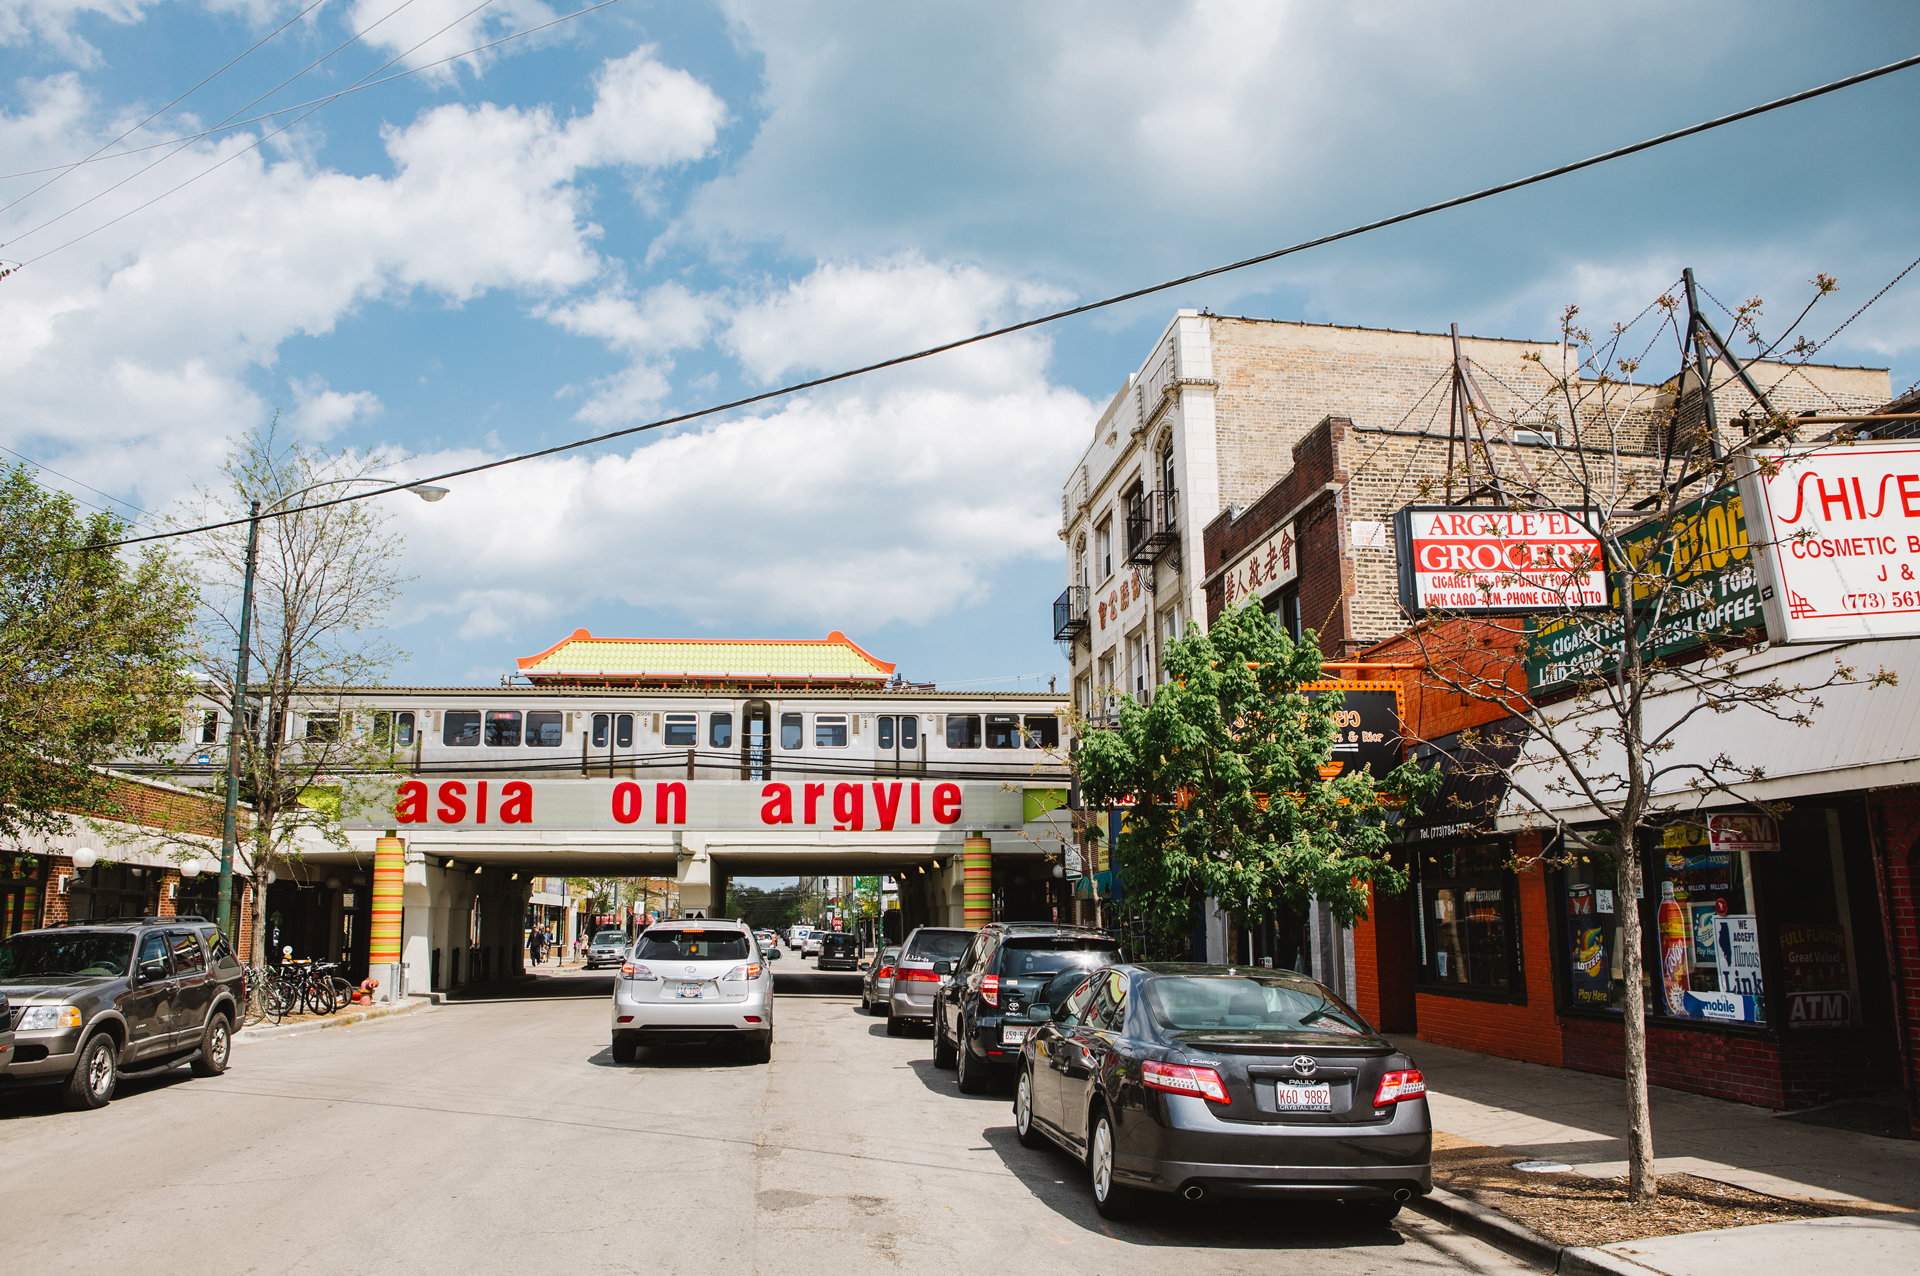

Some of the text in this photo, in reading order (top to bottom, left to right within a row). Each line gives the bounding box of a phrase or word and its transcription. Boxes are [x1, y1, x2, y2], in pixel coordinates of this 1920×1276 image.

[1420, 542, 1598, 570] GROCERY
[1791, 536, 1897, 559] COSMETIC
[1877, 563, 1915, 582] J &
[1424, 593, 1448, 606] LINK
[1841, 592, 1886, 612] (773)
[1646, 616, 1693, 650] RESH
[1348, 731, 1359, 742] &
[396, 780, 963, 832] asia on argyle
[1710, 882, 1729, 890] MILLION
[1738, 920, 1748, 929] WE
[1733, 932, 1754, 942] ACCEPT
[1577, 946, 1604, 970] LOTTERY
[1733, 945, 1759, 968] Illinois
[1788, 952, 1813, 963] Great
[1723, 970, 1764, 995] Link
[1578, 988, 1607, 1002] Play Here
[1790, 995, 1842, 1020] ATM
[1304, 1090, 1329, 1104] 9882
